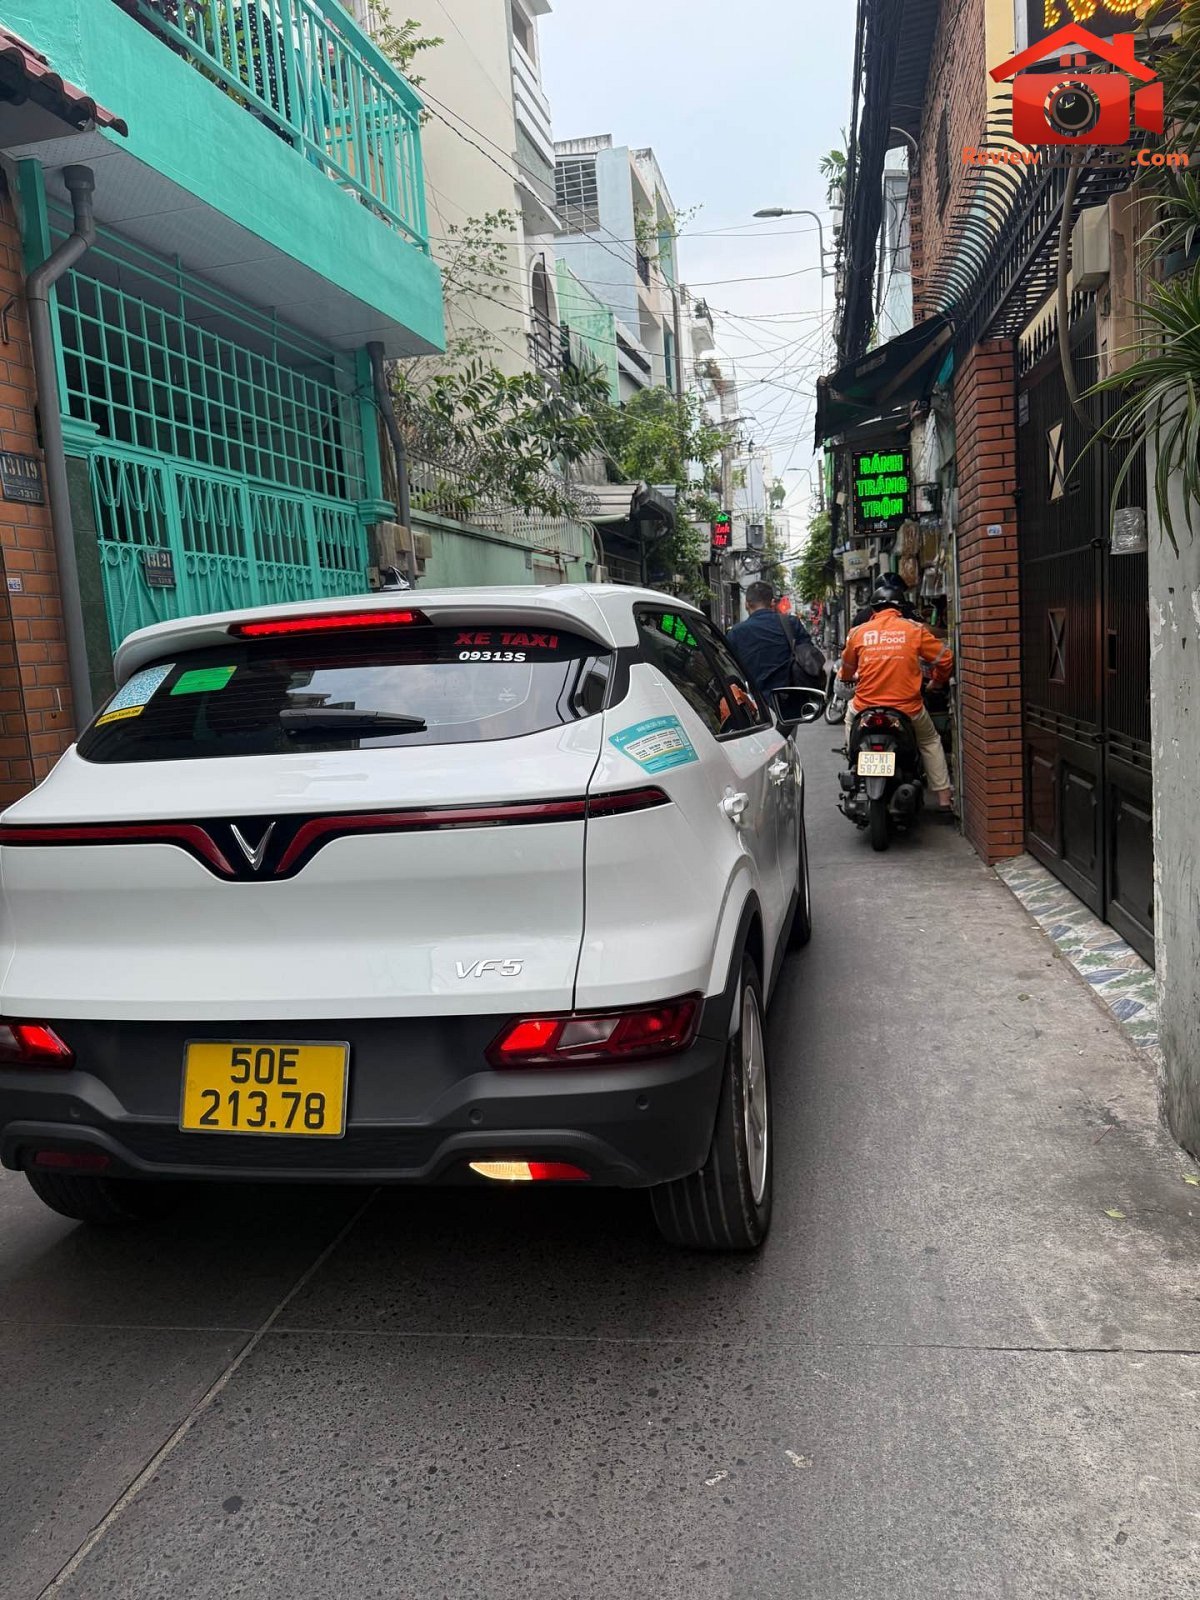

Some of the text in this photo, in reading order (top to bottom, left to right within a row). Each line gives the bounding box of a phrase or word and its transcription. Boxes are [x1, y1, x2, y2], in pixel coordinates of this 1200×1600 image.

[860, 453, 903, 475] BÁNH
[861, 496, 903, 519] TRỘN
[453, 632, 559, 648] XE TAXI
[880, 636, 906, 644] Food
[458, 651, 527, 662] 09313S
[455, 958, 525, 979] VF5
[230, 1047, 300, 1085] 50E
[199, 1089, 326, 1130] 213.78
